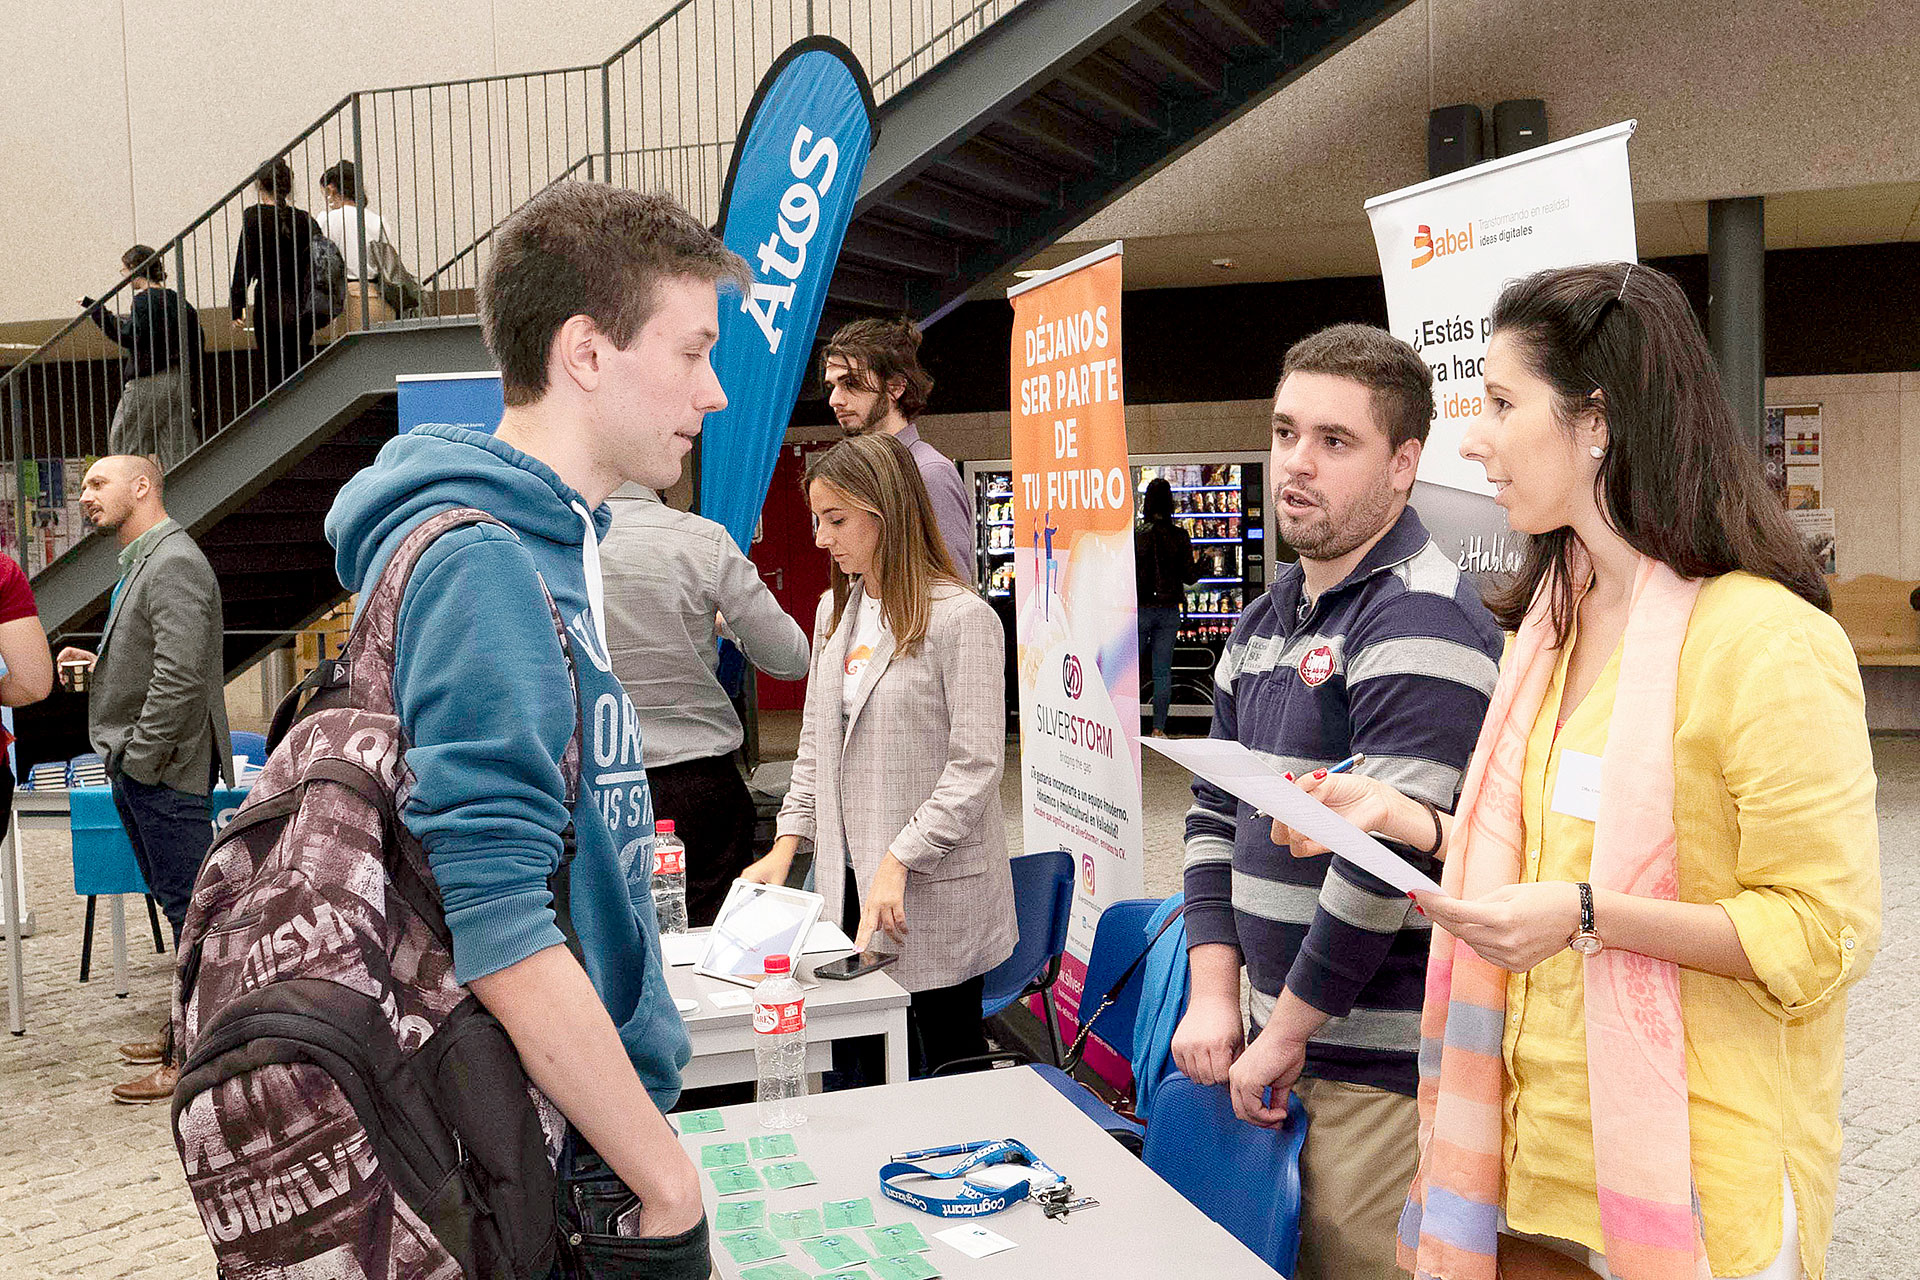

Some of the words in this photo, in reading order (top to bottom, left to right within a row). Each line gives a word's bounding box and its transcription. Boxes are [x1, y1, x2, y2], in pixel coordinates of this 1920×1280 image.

[1478, 209, 1530, 231] Transformando
[1530, 206, 1541, 217] en
[1542, 197, 1570, 215] realidad
[1479, 230, 1498, 247] ideas
[1499, 224, 1533, 243] digitales
[740, 124, 839, 355] Atos
[1411, 222, 1474, 269] Babel
[1025, 305, 1109, 367] DÉJANOS
[1413, 315, 1474, 353] ¿Estás
[1021, 374, 1051, 417] SER
[1056, 357, 1119, 409] PARTE
[1443, 392, 1484, 419] idea
[1054, 417, 1078, 460] DE
[1022, 472, 1041, 511] TU
[1047, 467, 1125, 511] FUTURO
[1036, 703, 1113, 760] SILVERSTORM
[942, 1196, 1006, 1218] Cognizant
